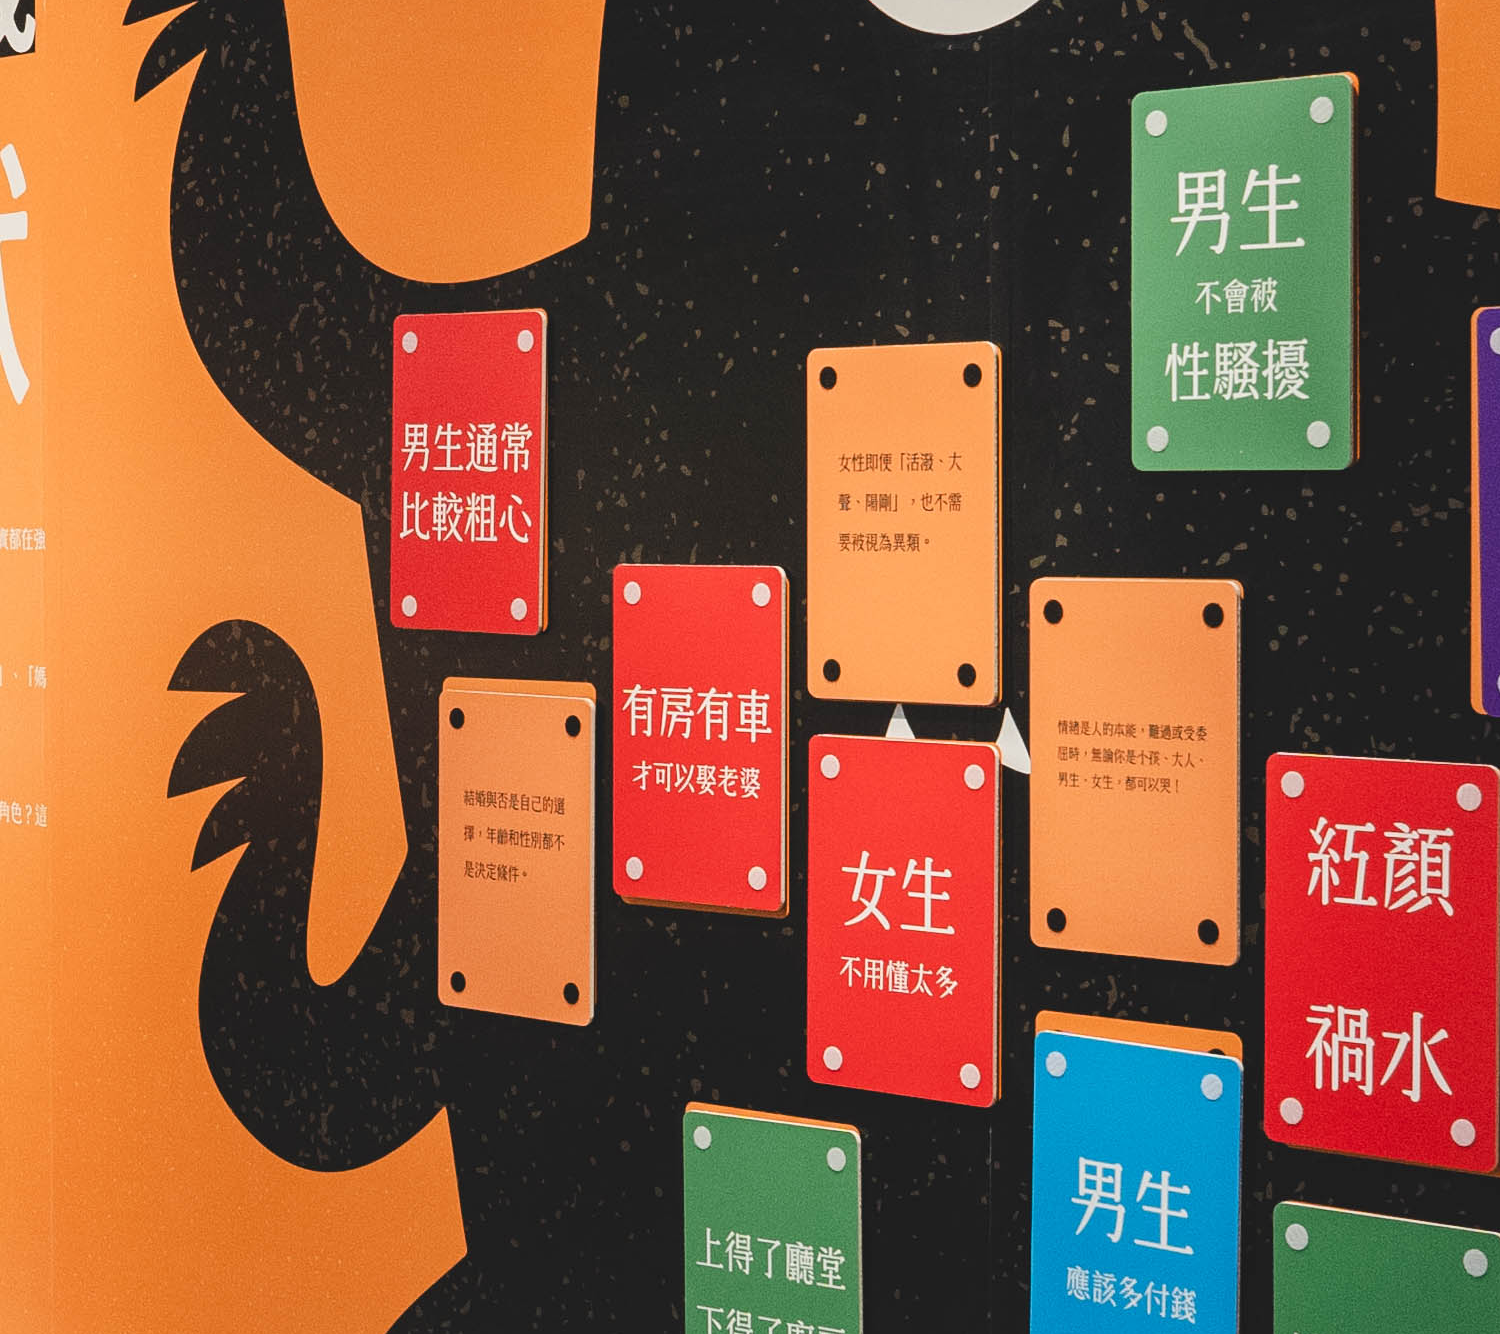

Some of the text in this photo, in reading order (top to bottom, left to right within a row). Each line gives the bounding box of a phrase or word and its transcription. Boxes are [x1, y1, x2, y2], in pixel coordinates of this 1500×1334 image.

[1171, 164, 1304, 256] 男生
[1196, 277, 1277, 314] 不會被
[1165, 339, 1309, 402] 性騷擾
[402, 422, 532, 472] 男生通常
[400, 492, 531, 543] 比較粗心
[623, 684, 772, 742] 有房有車
[633, 761, 760, 798] 才可以娶老婆
[842, 851, 954, 934] 女生
[1308, 817, 1453, 916] 紅顏
[840, 957, 957, 998] 不用懂太多
[1306, 1005, 1452, 1102] 禍水
[1072, 1157, 1193, 1254] 男生
[696, 1228, 845, 1290] 上得了廳堂
[1067, 1266, 1196, 1323] 應該多付錢
